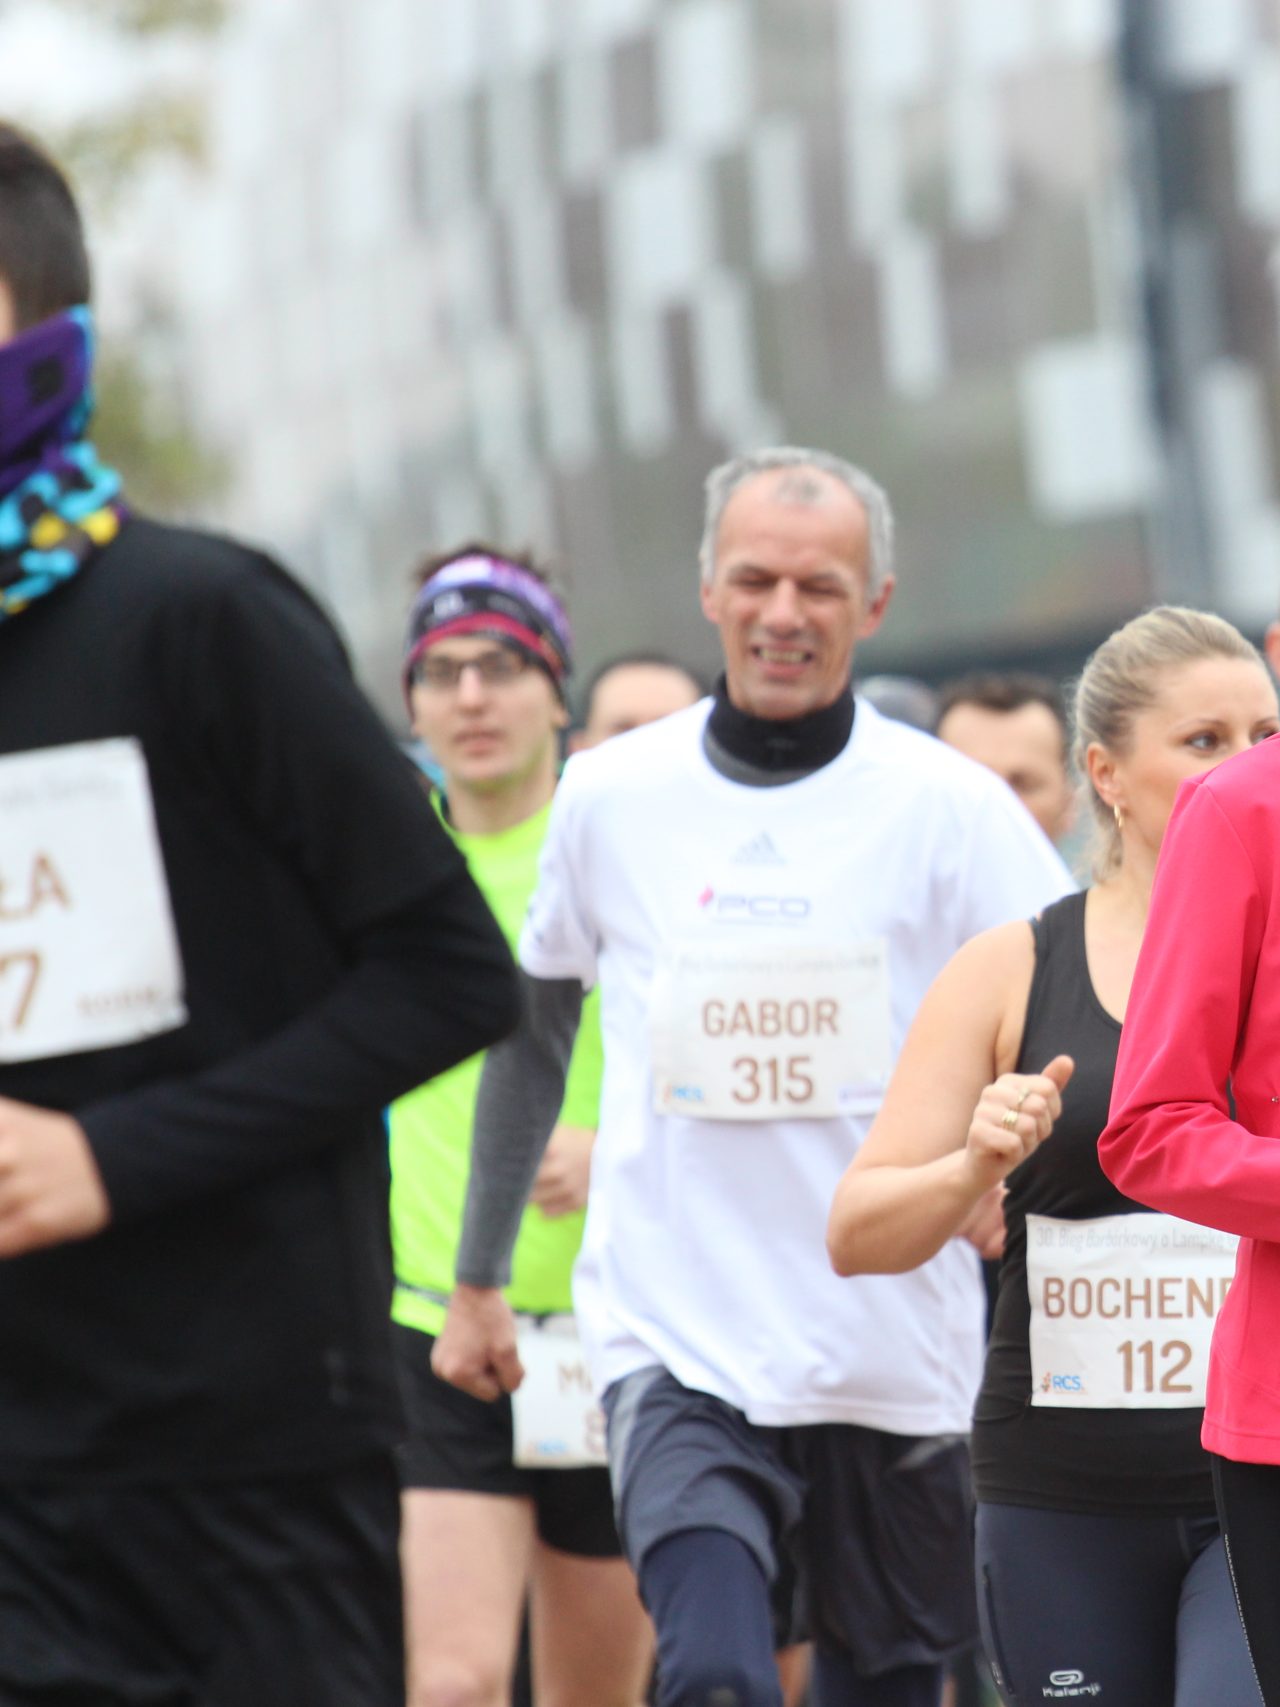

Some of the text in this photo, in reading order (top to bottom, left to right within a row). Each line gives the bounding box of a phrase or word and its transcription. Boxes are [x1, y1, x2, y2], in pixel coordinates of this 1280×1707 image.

[702, 998, 840, 1038] GABOR
[731, 1054, 815, 1105] 315
[1057, 1226, 1084, 1252] Bieg
[1160, 1233, 1169, 1247] o
[1116, 1339, 1193, 1393] 112
